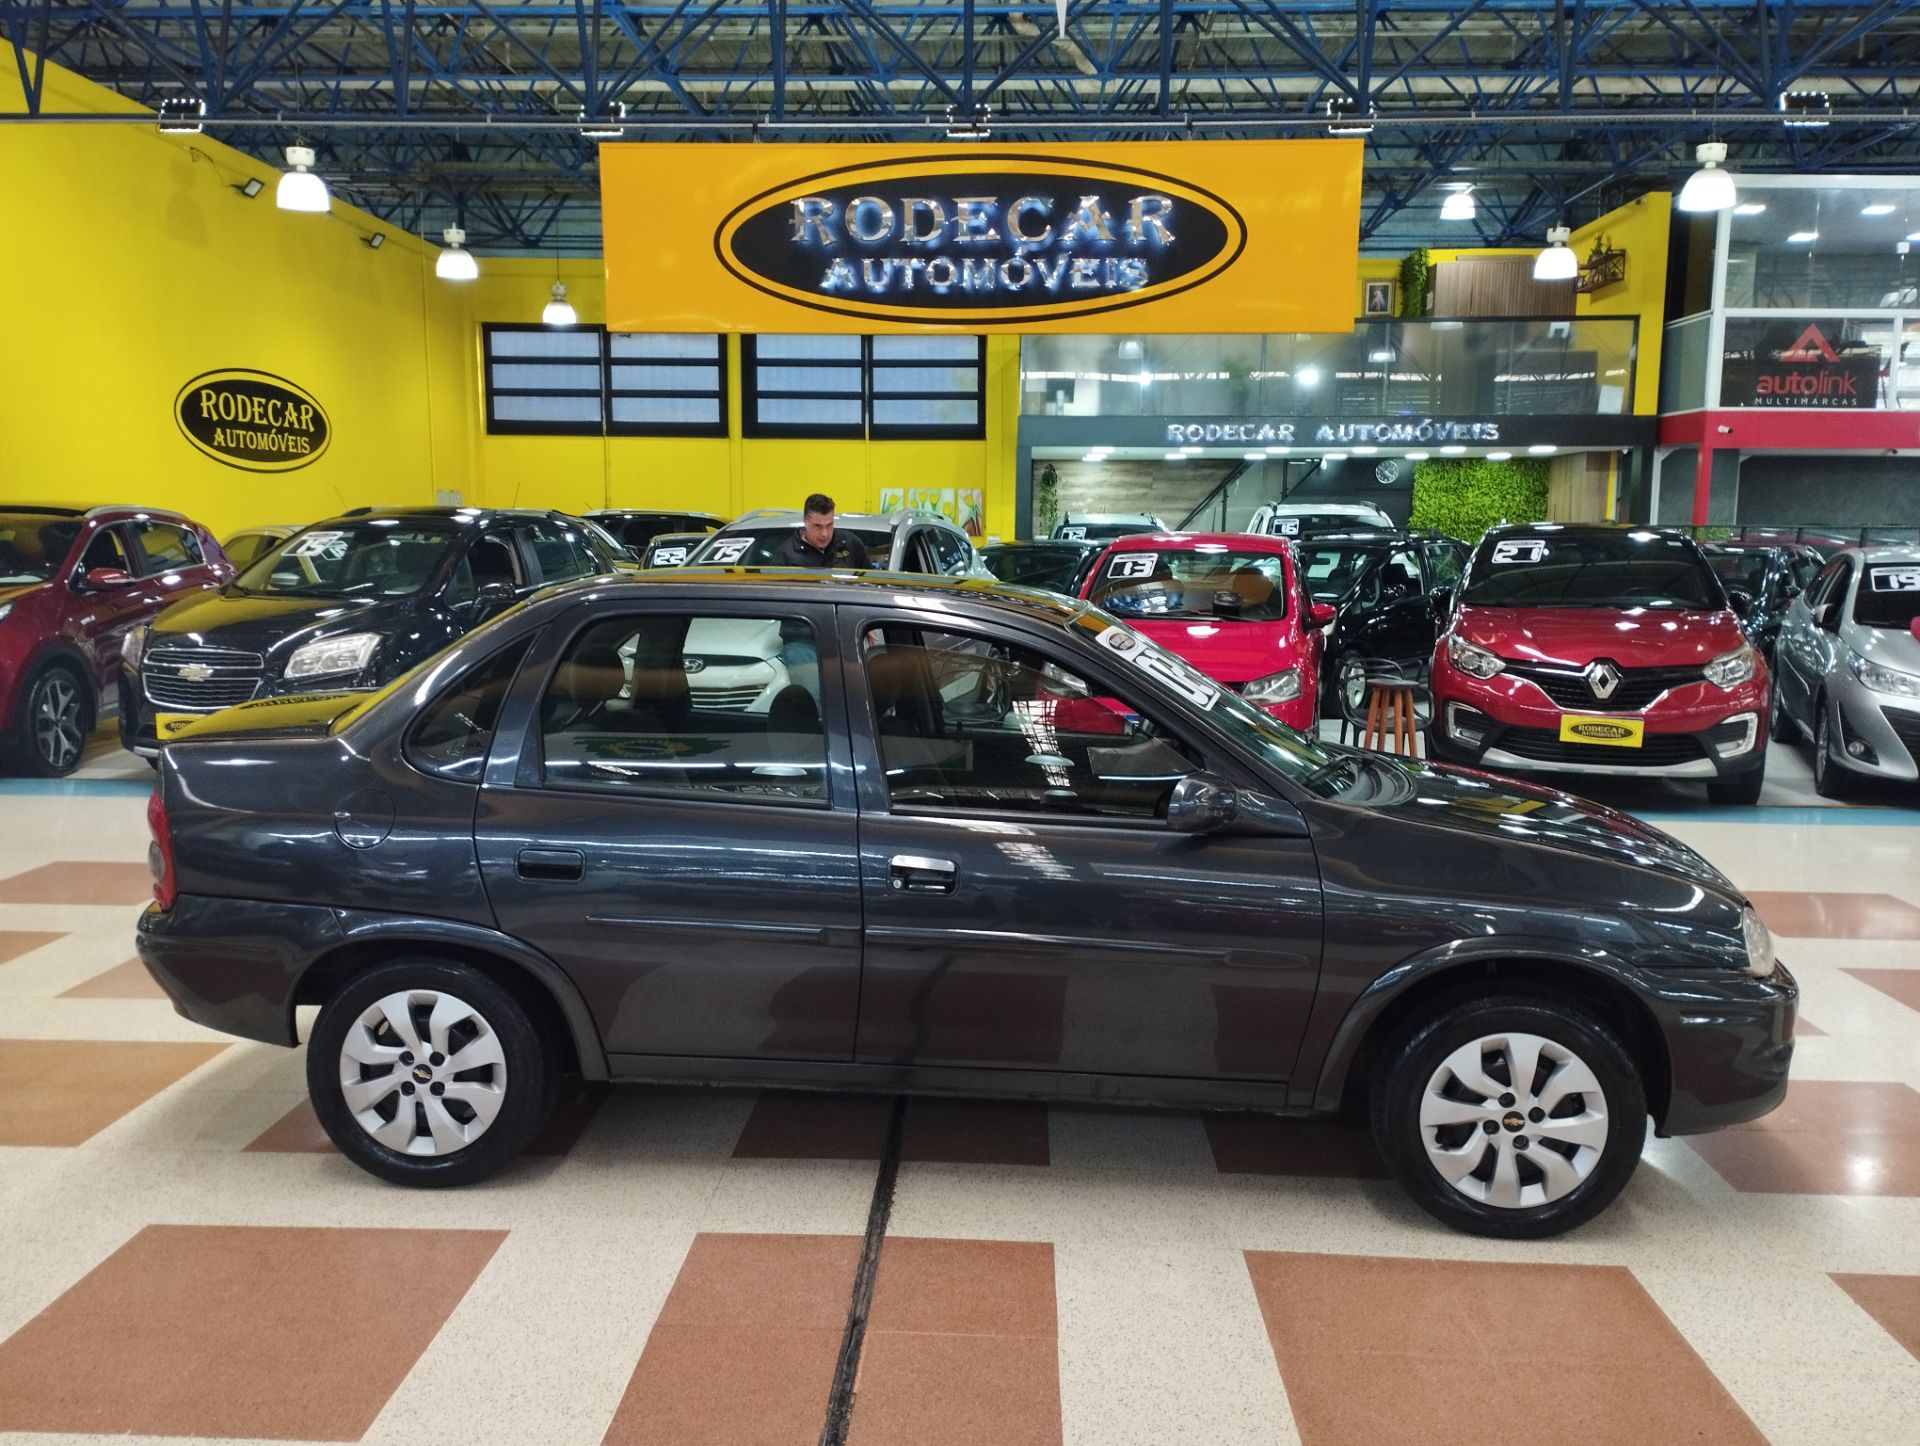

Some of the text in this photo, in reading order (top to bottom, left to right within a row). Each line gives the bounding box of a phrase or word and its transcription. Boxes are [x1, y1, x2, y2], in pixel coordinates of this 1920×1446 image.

[788, 195, 1175, 246] RODECAR
[819, 246, 1149, 288] AUTOMÓVEIS
[1756, 370, 1857, 395] autolink
[1754, 397, 1857, 406] MULTIMARCAS
[200, 389, 315, 433] RODECAR
[1167, 418, 1500, 441] RODECAR AUTOMÓVEIS
[213, 427, 311, 454] AUTOMÓVEIS
[656, 551, 685, 564] 22
[713, 545, 744, 562] 15
[1495, 545, 1540, 562] 21
[1122, 560, 1153, 577] 13
[1889, 573, 1920, 590] 19
[1578, 724, 1625, 735] RODECAR
